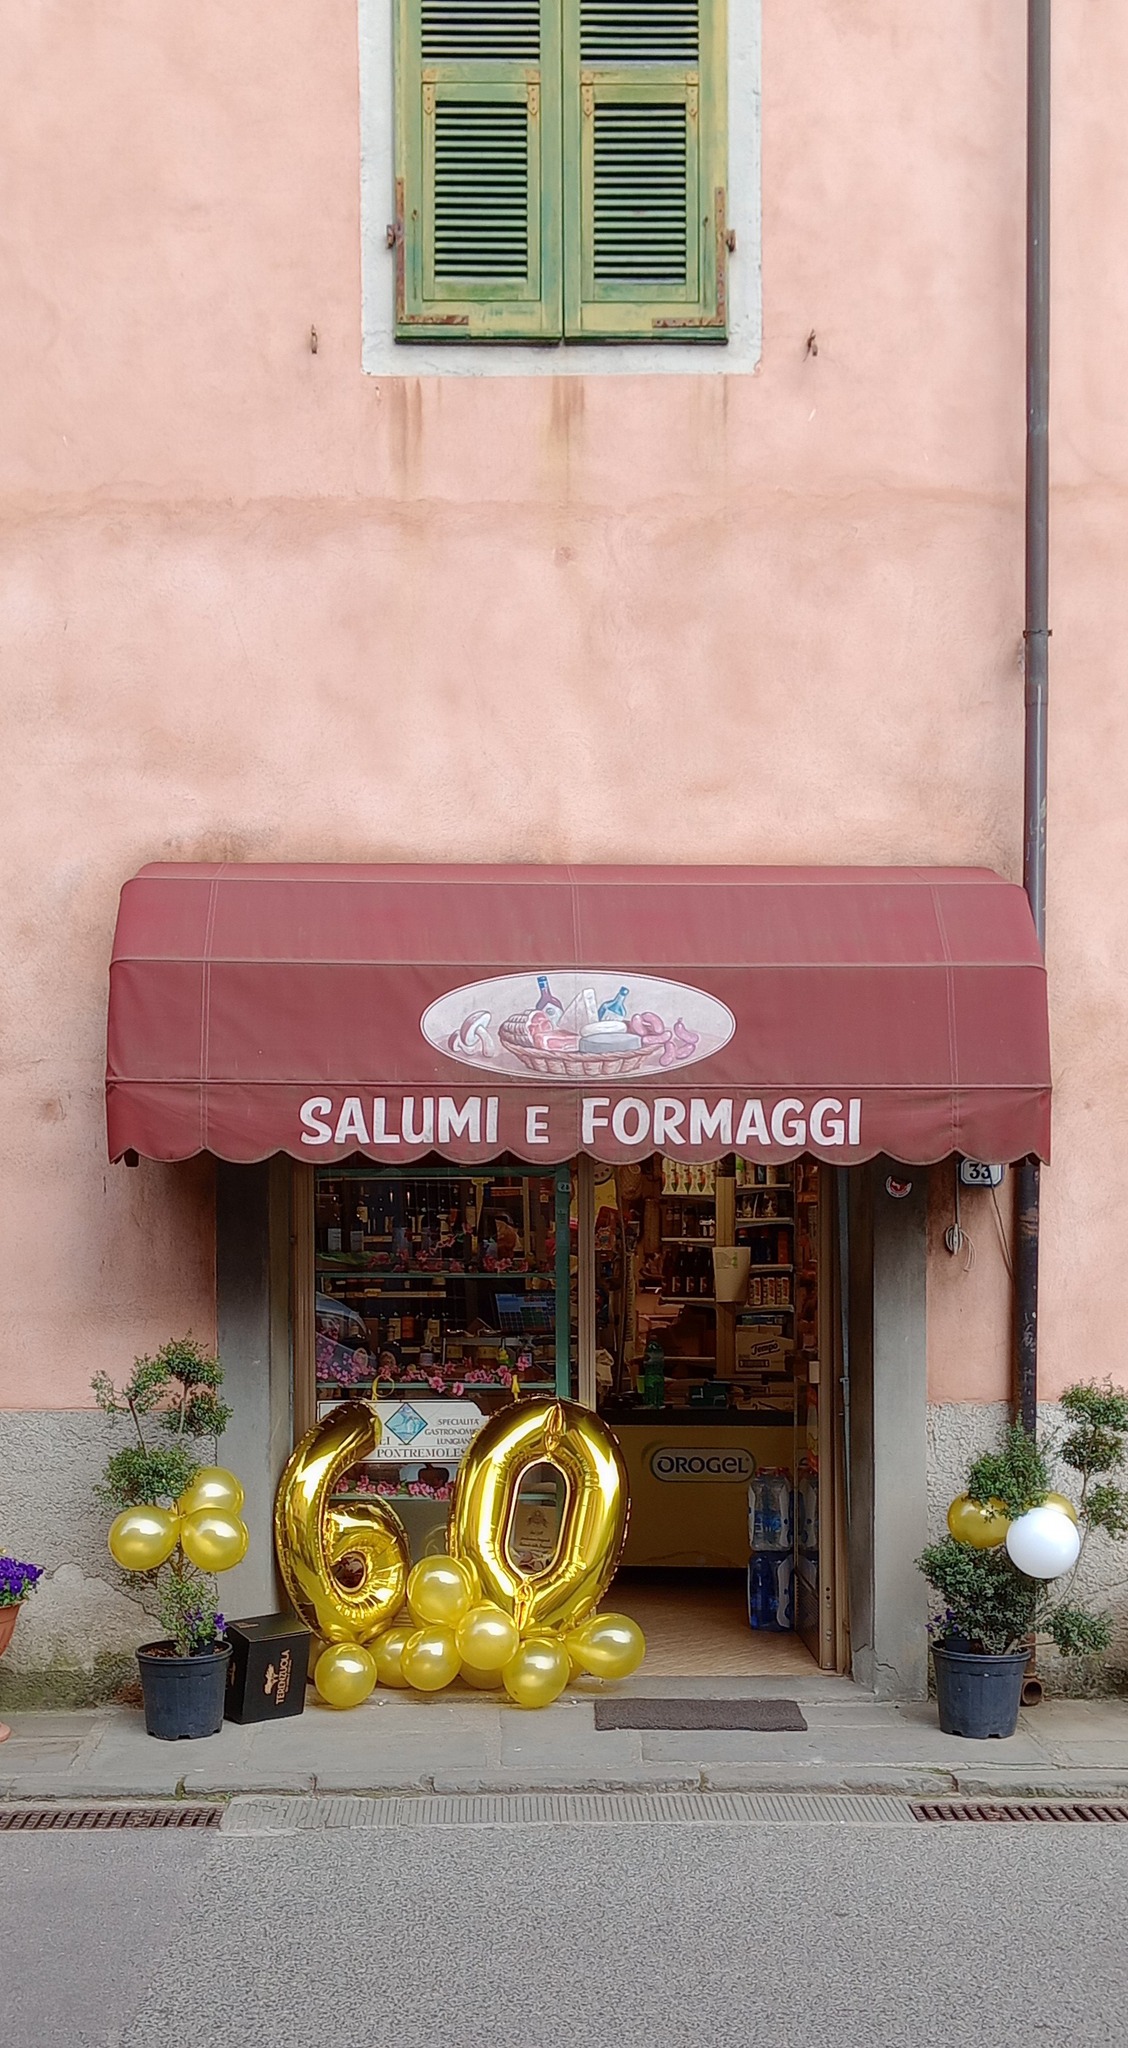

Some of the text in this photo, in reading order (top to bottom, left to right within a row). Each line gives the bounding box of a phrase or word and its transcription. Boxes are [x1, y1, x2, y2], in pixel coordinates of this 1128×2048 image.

[300, 1096, 862, 1146] SALUMI E FORMAGGI
[969, 1163, 992, 1180] 33
